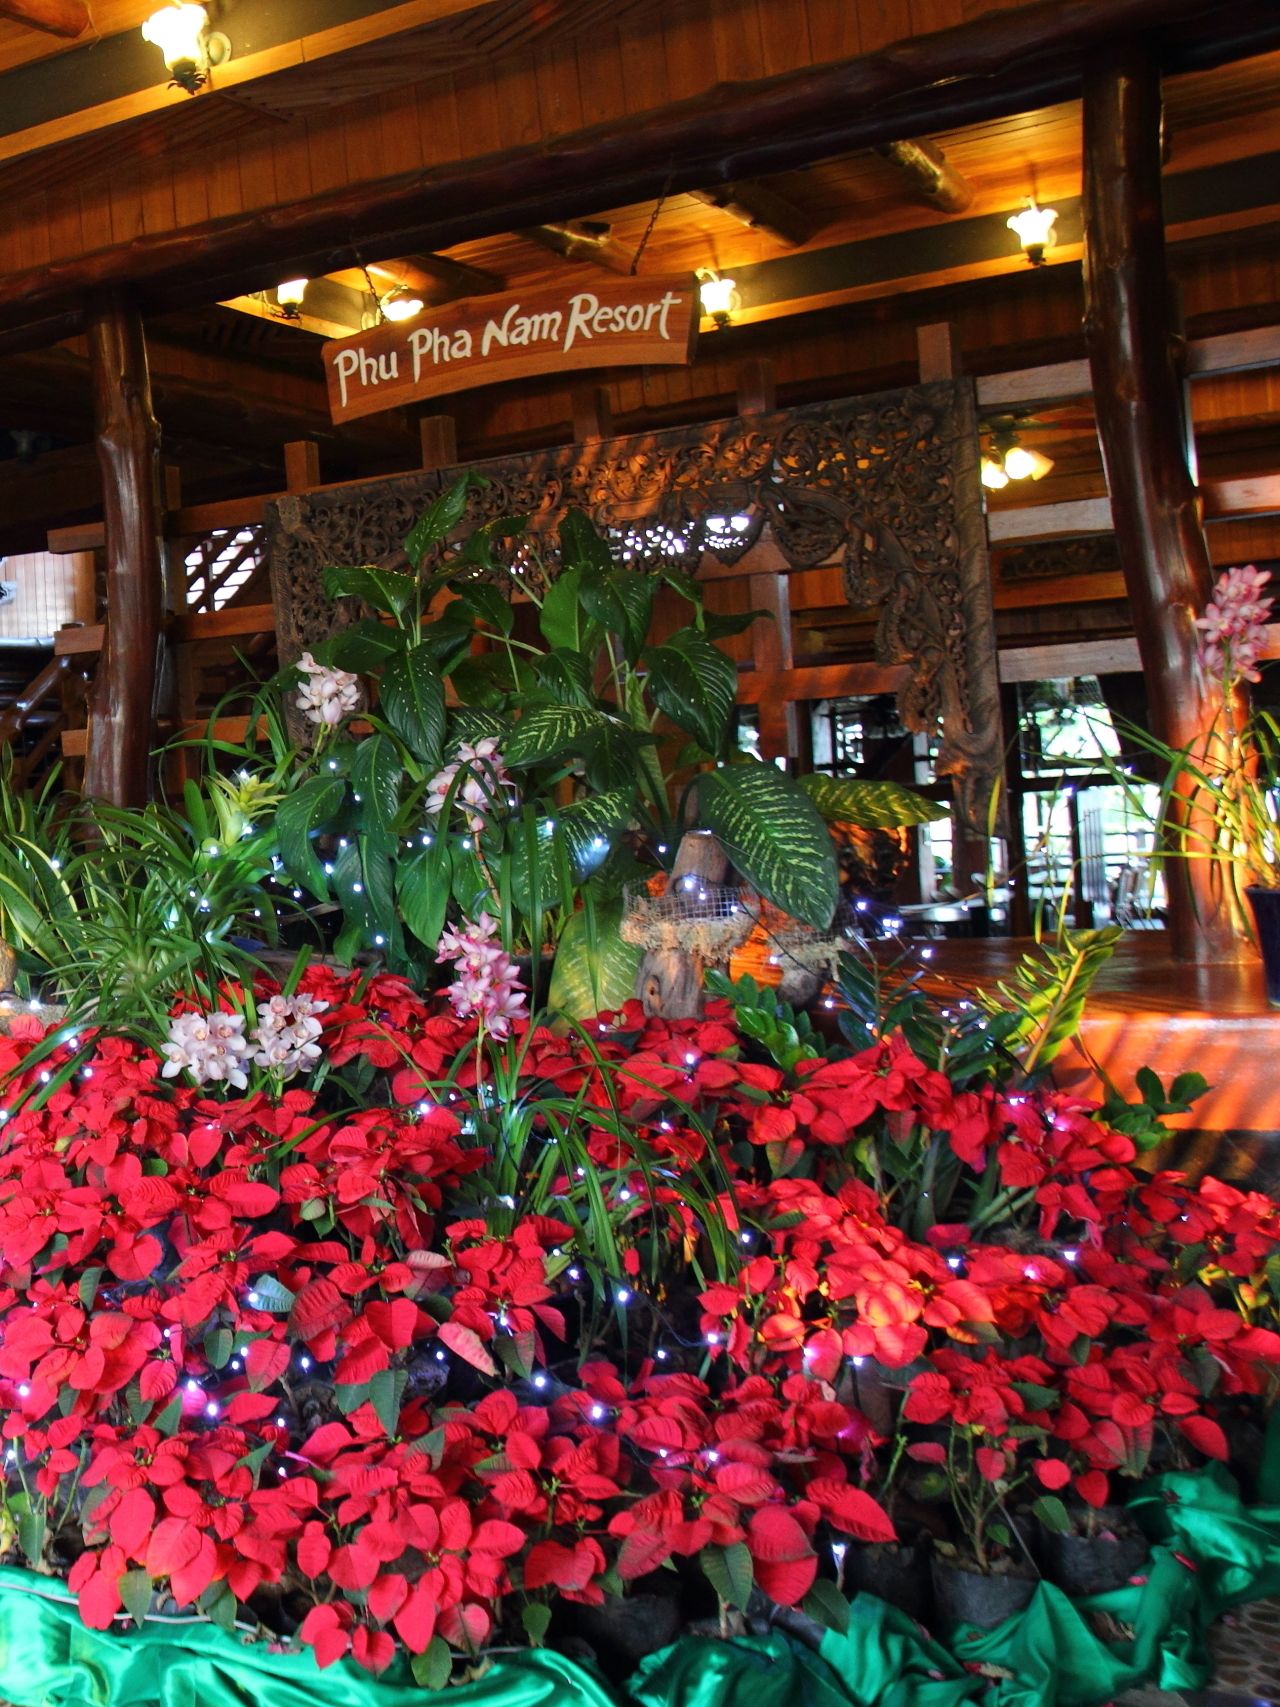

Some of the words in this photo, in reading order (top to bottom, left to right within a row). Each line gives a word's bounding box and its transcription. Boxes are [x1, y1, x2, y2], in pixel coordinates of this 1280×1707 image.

[333, 348, 399, 407] Phu
[407, 328, 472, 383] Pha
[481, 304, 562, 356] Nam
[563, 291, 682, 353] Resort
